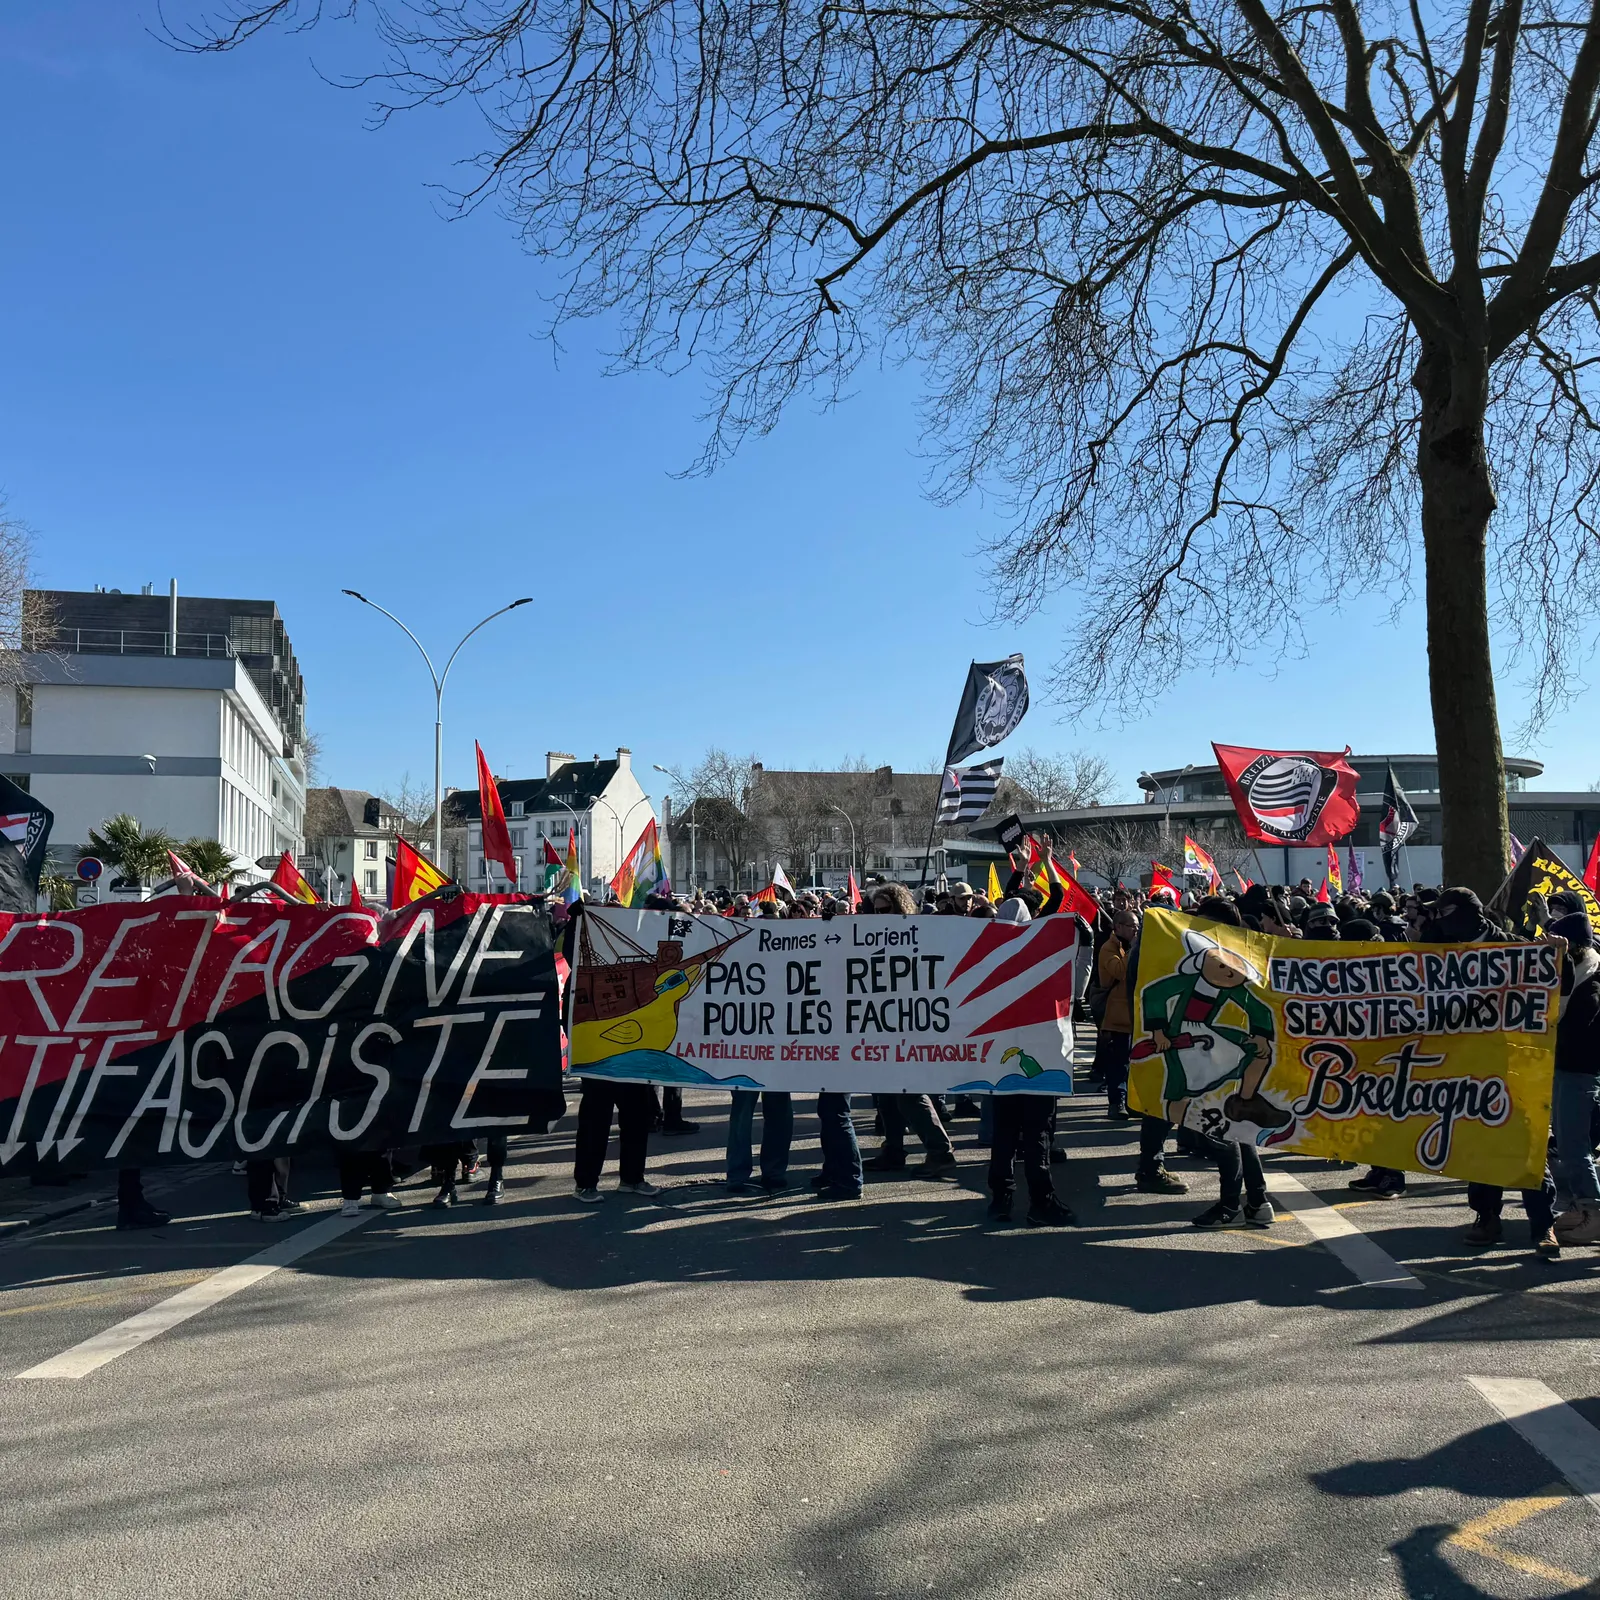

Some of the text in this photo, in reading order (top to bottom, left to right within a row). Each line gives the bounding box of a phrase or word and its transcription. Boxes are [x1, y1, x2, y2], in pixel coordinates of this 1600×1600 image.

[759, 923, 918, 952] Rennes Lorient
[705, 961, 766, 996] PAS
[786, 960, 821, 996] DE
[703, 997, 950, 1036] POUR LES FACHOS
[1427, 991, 1500, 1033] HORS
[1502, 990, 1548, 1032] DE
[676, 1042, 696, 1059] LA
[780, 1039, 840, 1061] DÉFENSE
[851, 1038, 890, 1062] C'EST
[1292, 1041, 1508, 1169] Bretagne
